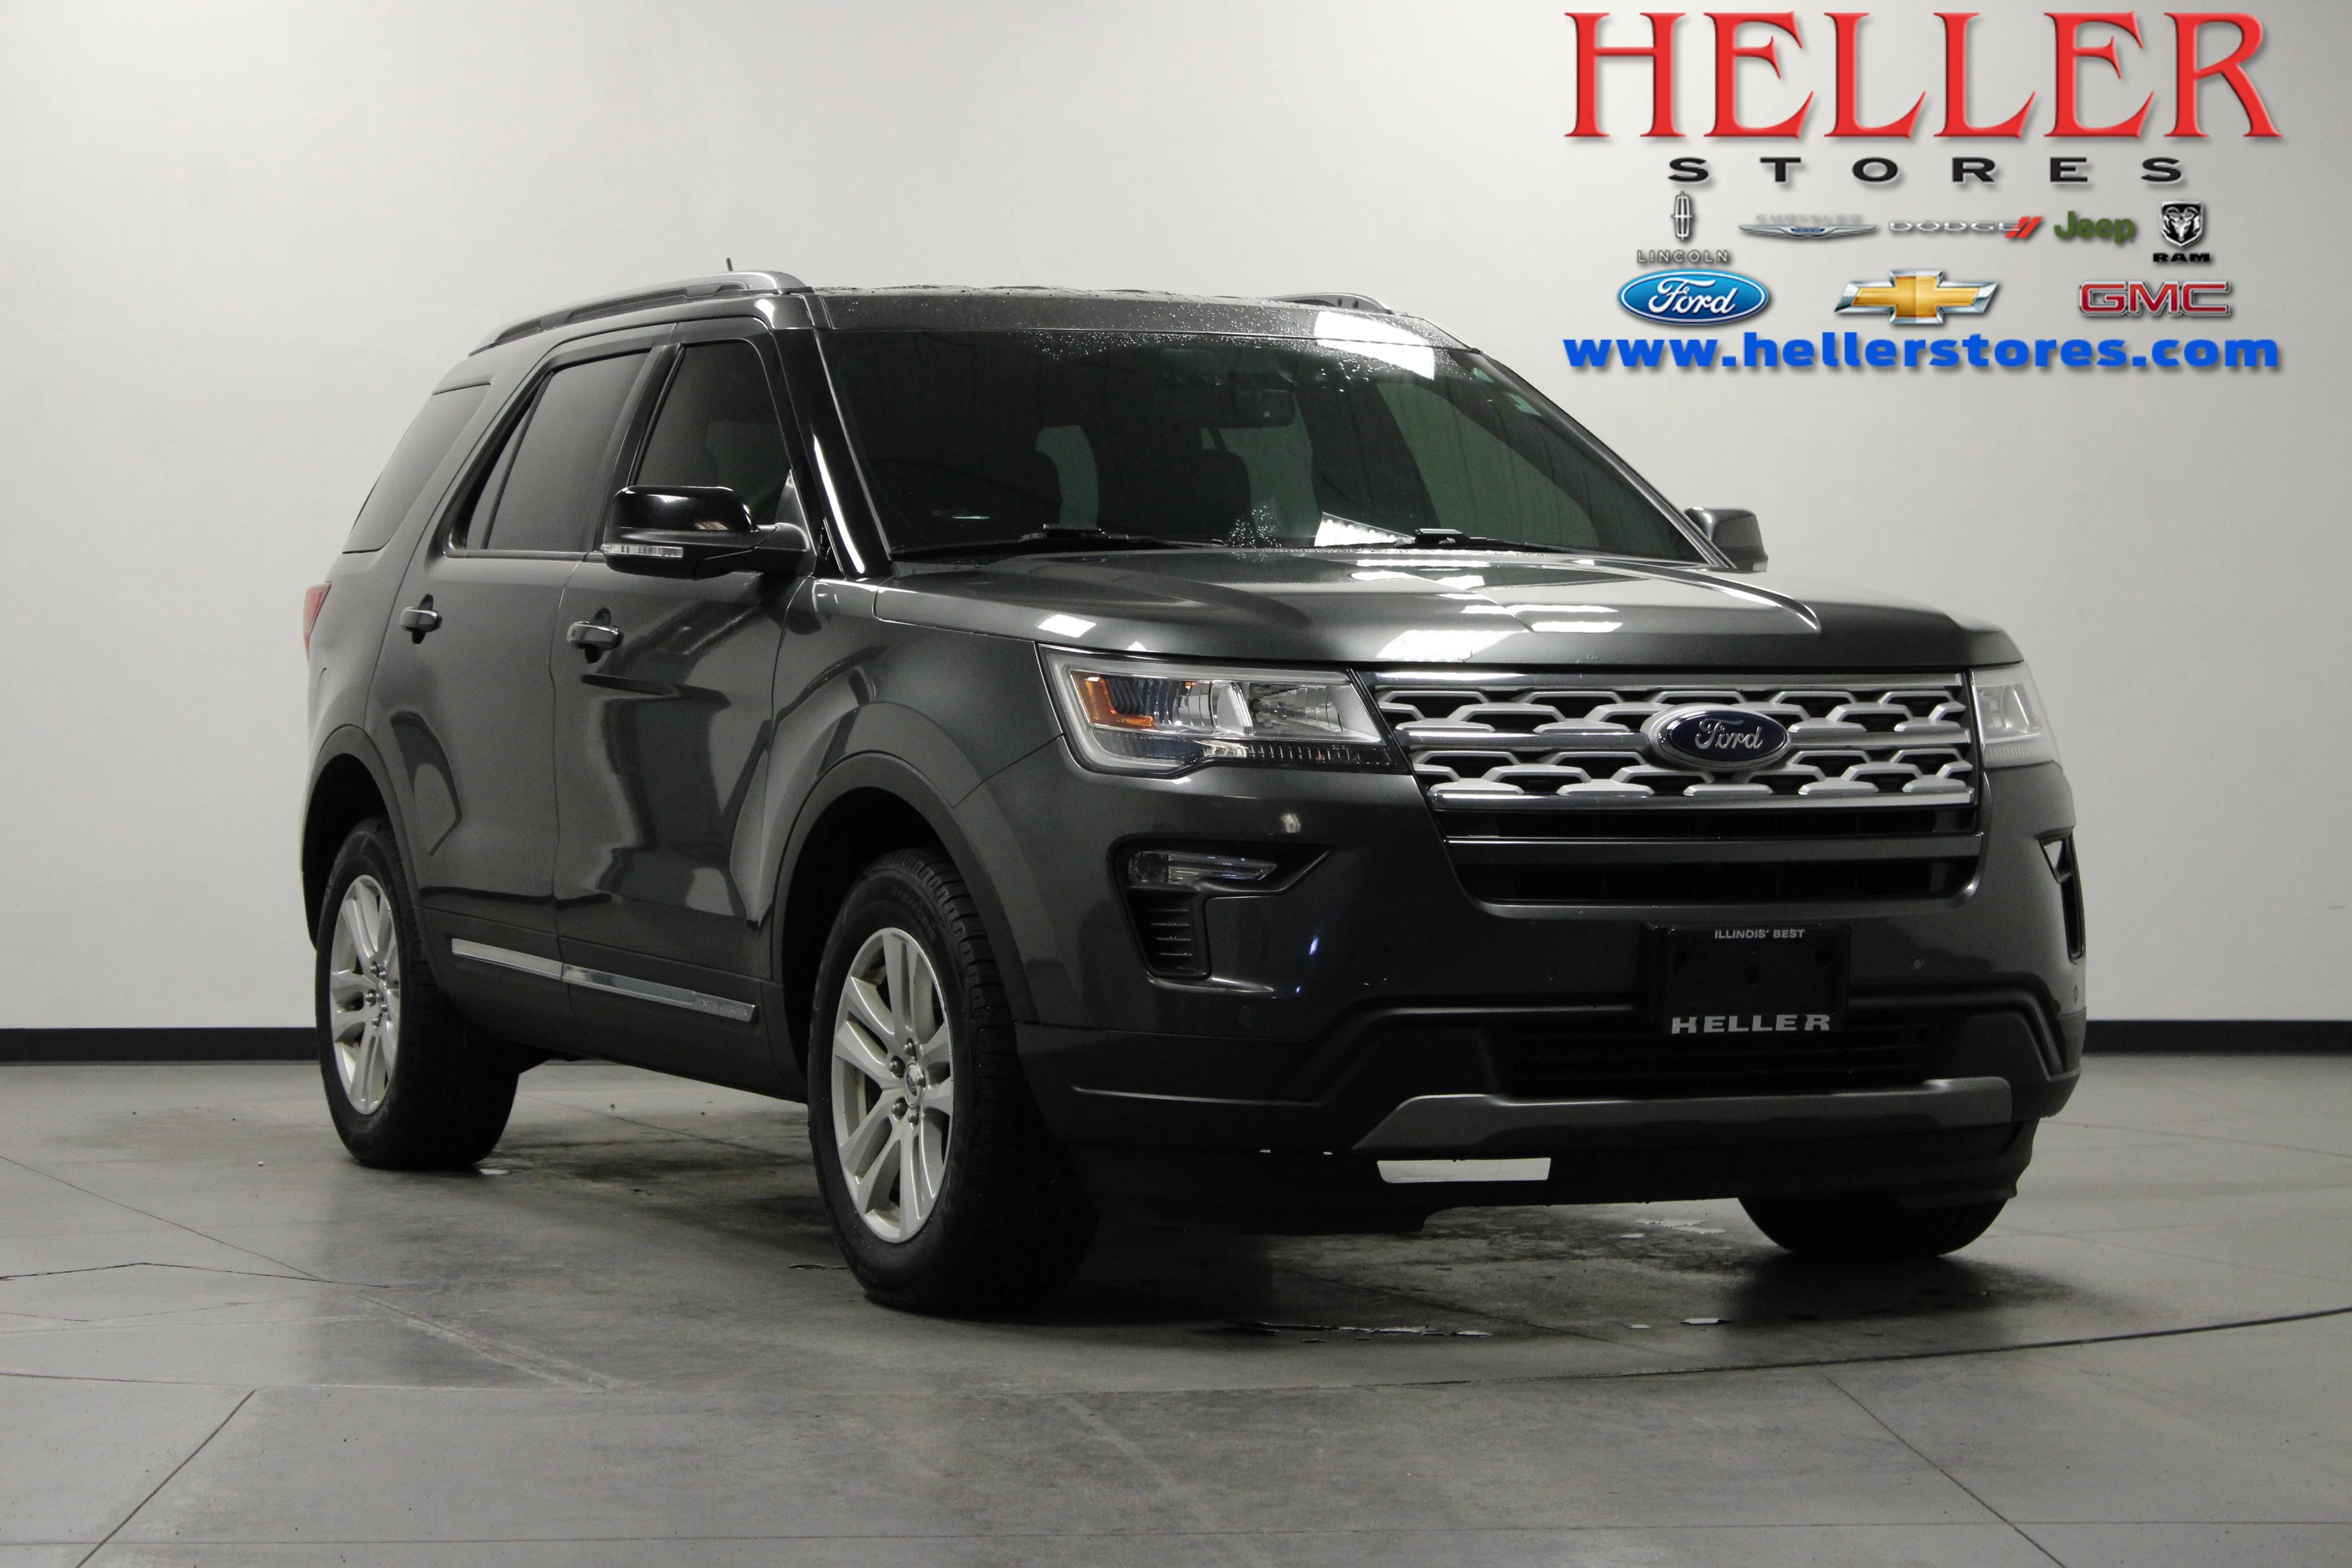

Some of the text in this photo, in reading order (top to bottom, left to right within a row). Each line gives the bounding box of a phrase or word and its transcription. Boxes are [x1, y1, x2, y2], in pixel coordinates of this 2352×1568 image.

[1694, 718, 1763, 750] Ford
[1773, 929, 1805, 939] BEST
[1671, 1014, 1831, 1034] HELLER
